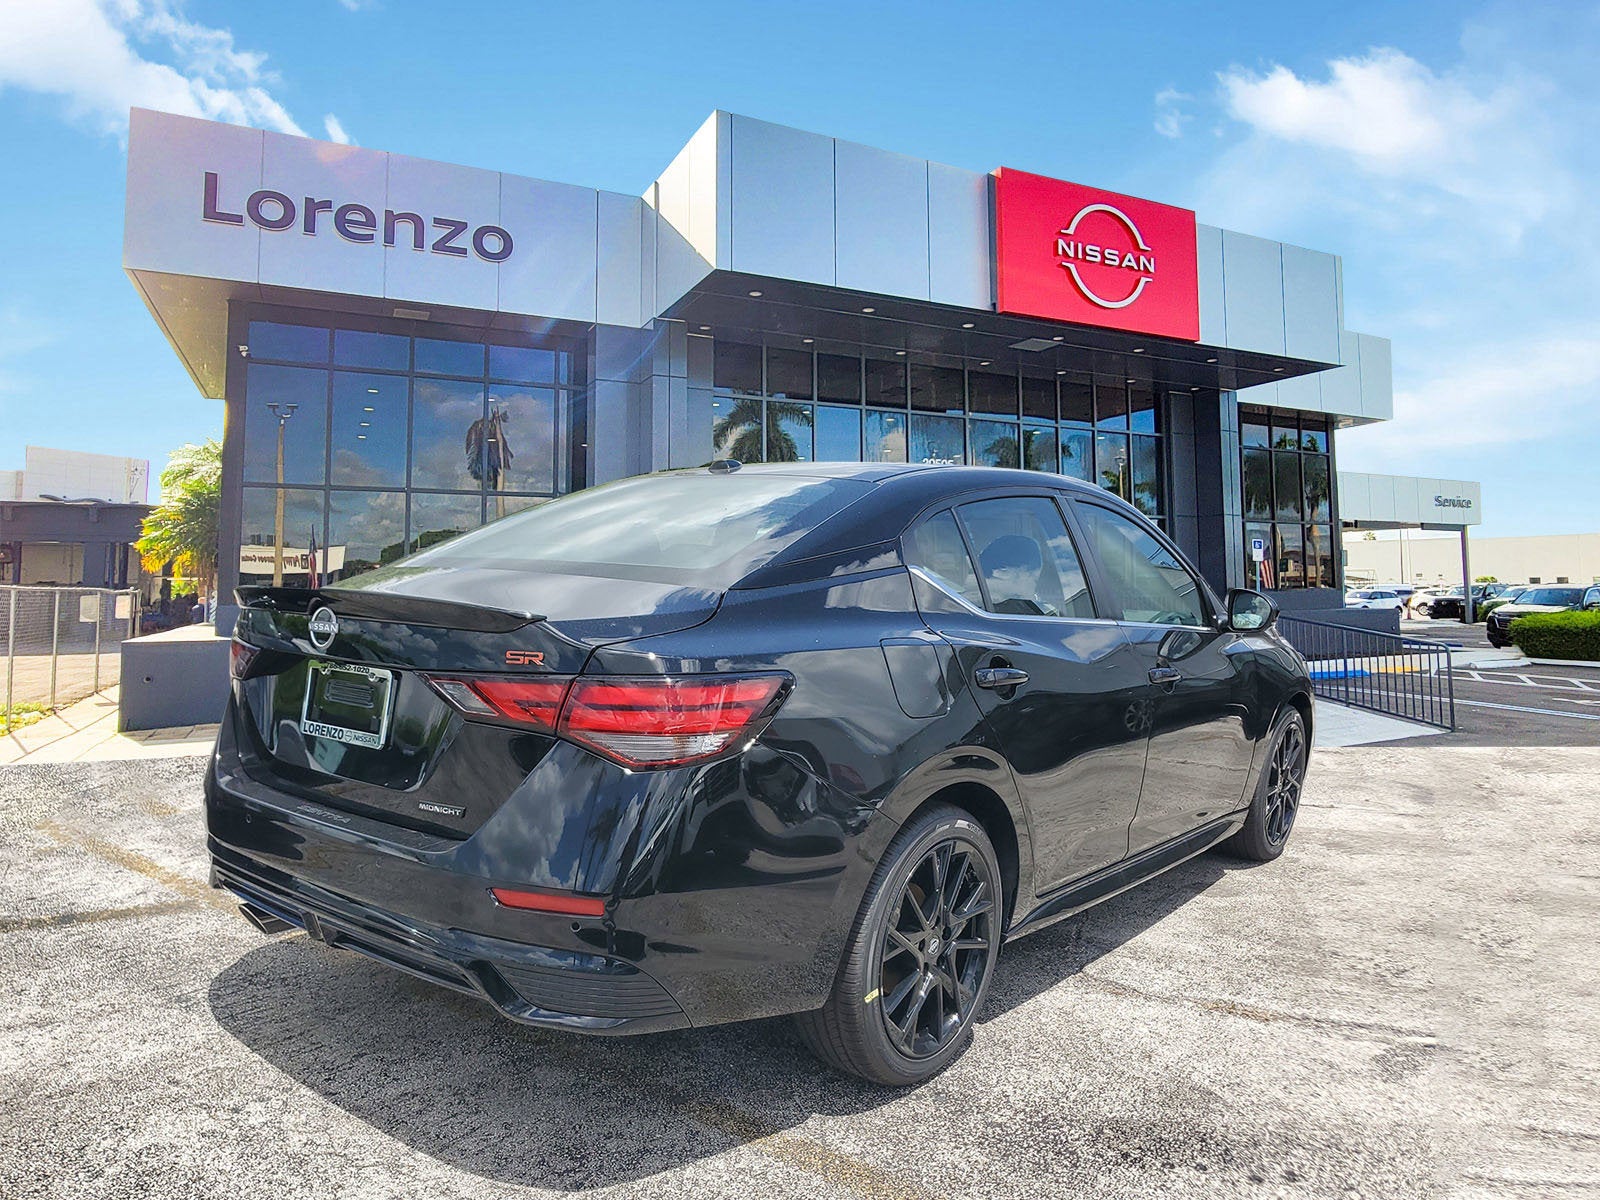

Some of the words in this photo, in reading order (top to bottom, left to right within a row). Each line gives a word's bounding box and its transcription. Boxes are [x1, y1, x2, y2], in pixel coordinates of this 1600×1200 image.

[202, 171, 514, 263] Lorenzo
[1057, 238, 1155, 273] NISSAN
[1434, 495, 1472, 509] Service
[505, 650, 545, 666] SR
[303, 722, 344, 740] LORENZO
[353, 734, 377, 745] NISSAN
[418, 802, 463, 816] MIDNIGHT
